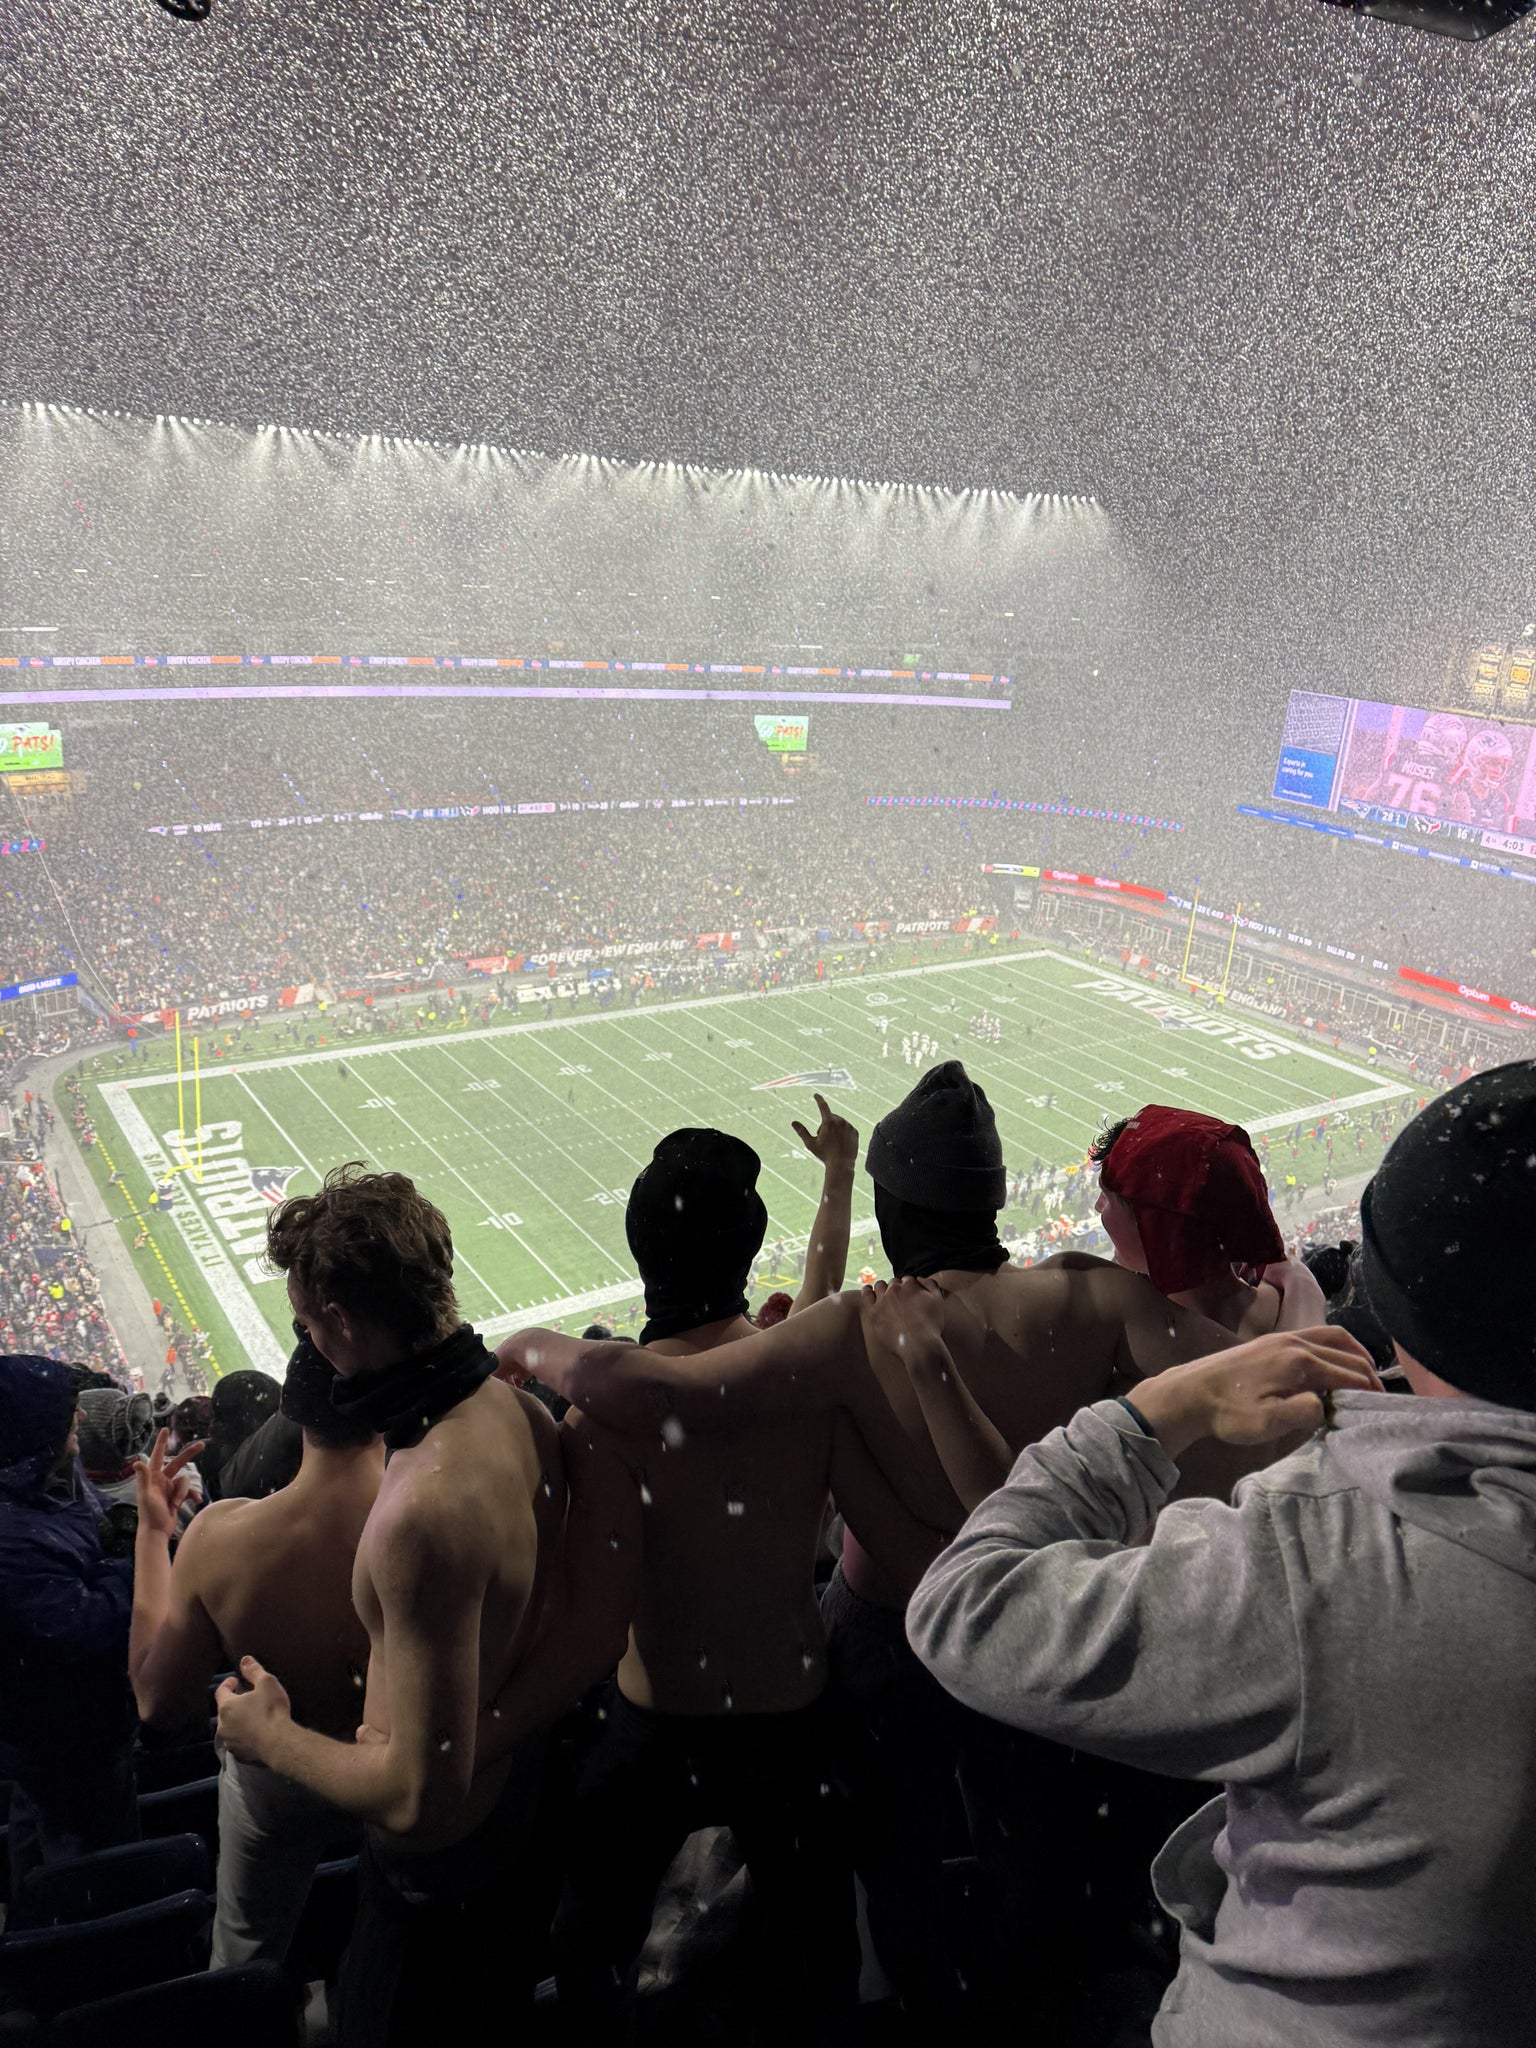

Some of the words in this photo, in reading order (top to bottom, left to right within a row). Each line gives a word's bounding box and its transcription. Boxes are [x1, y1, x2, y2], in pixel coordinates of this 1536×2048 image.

[775, 725, 804, 740] PATS!
[11, 735, 55, 753] PATS!
[1401, 759, 1437, 780] MOSES
[1384, 773, 1441, 816] 76
[1381, 811, 1393, 823] 28
[1456, 827, 1468, 840] 16
[1502, 838, 1524, 852] 4:03
[1052, 870, 1079, 882] Optum
[1094, 877, 1121, 889] Optum
[896, 921, 951, 933] PATRIOTS
[530, 948, 593, 966] FOREVER
[18, 981, 37, 994] BUD
[37, 977, 62, 991] LIGHT
[1458, 984, 1490, 1002] Optum
[187, 994, 268, 1021] PATRIOTS
[1071, 979, 1292, 1061] PATRIOTS
[143, 1153, 166, 1167] US
[594, 1188, 631, 1205] 20
[176, 1210, 213, 1250] TAKES
[487, 1212, 524, 1230] 10
[200, 1254, 225, 1268] IT
